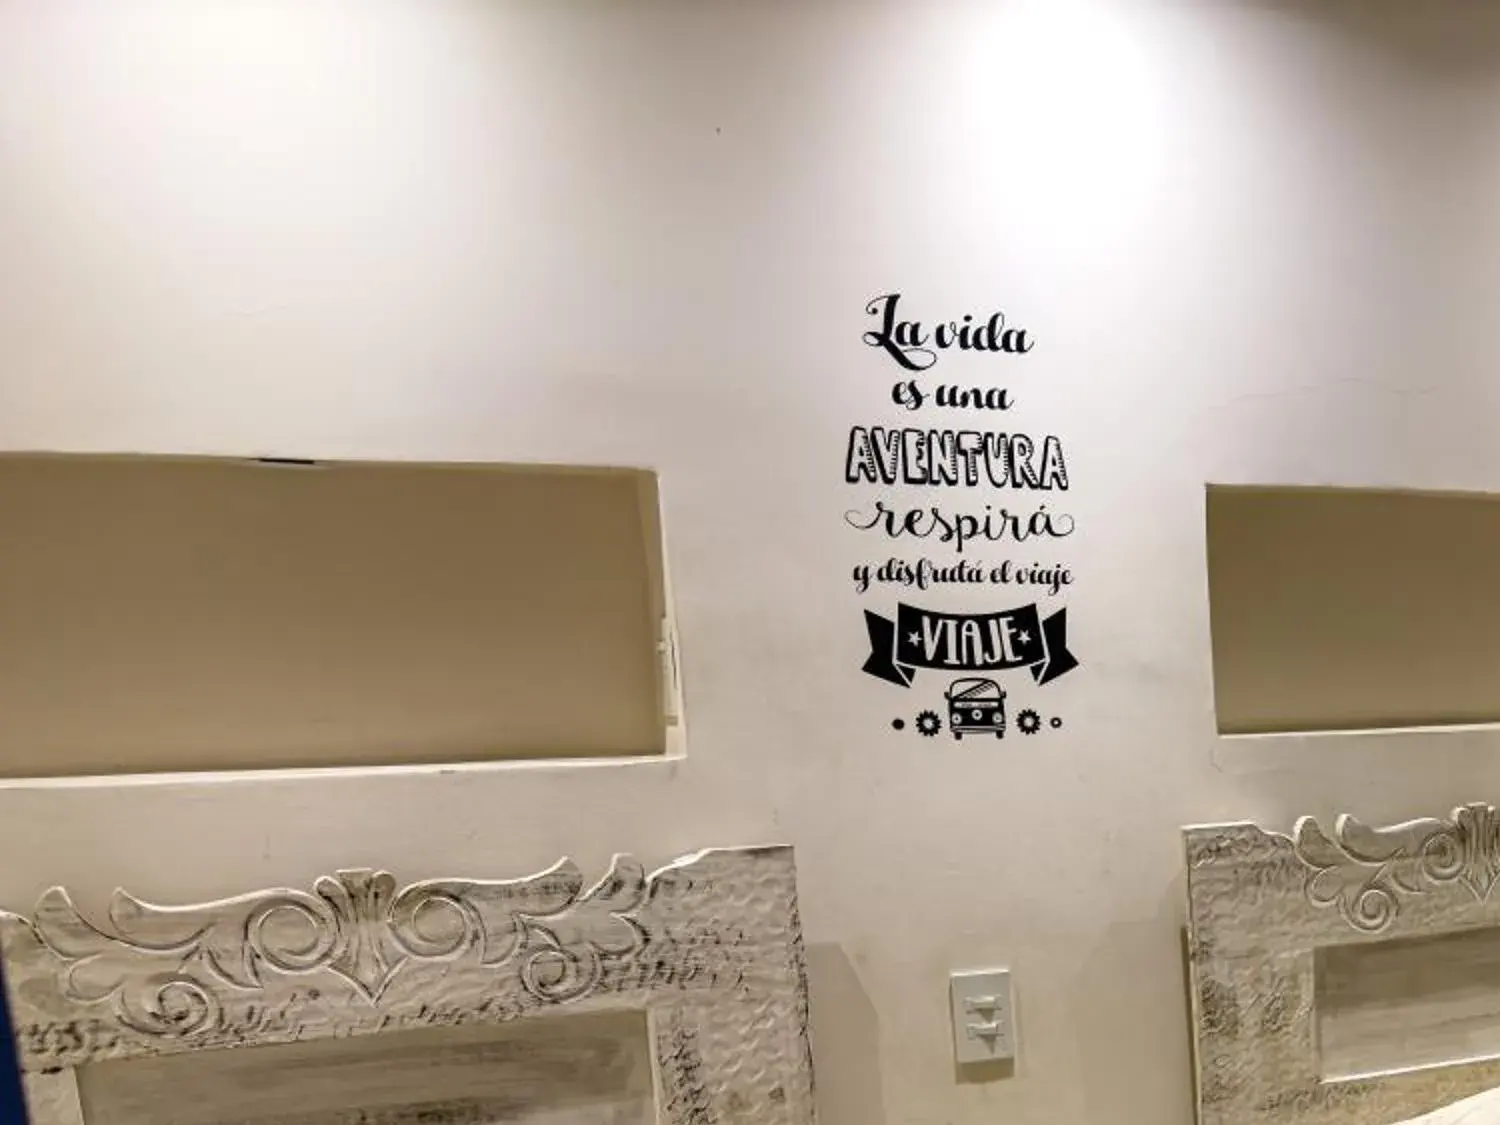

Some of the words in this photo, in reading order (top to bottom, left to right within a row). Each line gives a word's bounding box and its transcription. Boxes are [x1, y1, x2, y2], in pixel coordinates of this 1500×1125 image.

[863, 293, 937, 371] La
[935, 312, 1034, 354] vida
[892, 379, 927, 411] es
[935, 384, 1014, 411] una
[845, 425, 1069, 492] AVENTURA
[844, 501, 1075, 553] respirá
[853, 564, 870, 594] y
[876, 557, 986, 591] disfrutá
[989, 559, 1012, 584] el
[1015, 562, 1074, 596] viaje
[920, 615, 1023, 667] VIAJE
